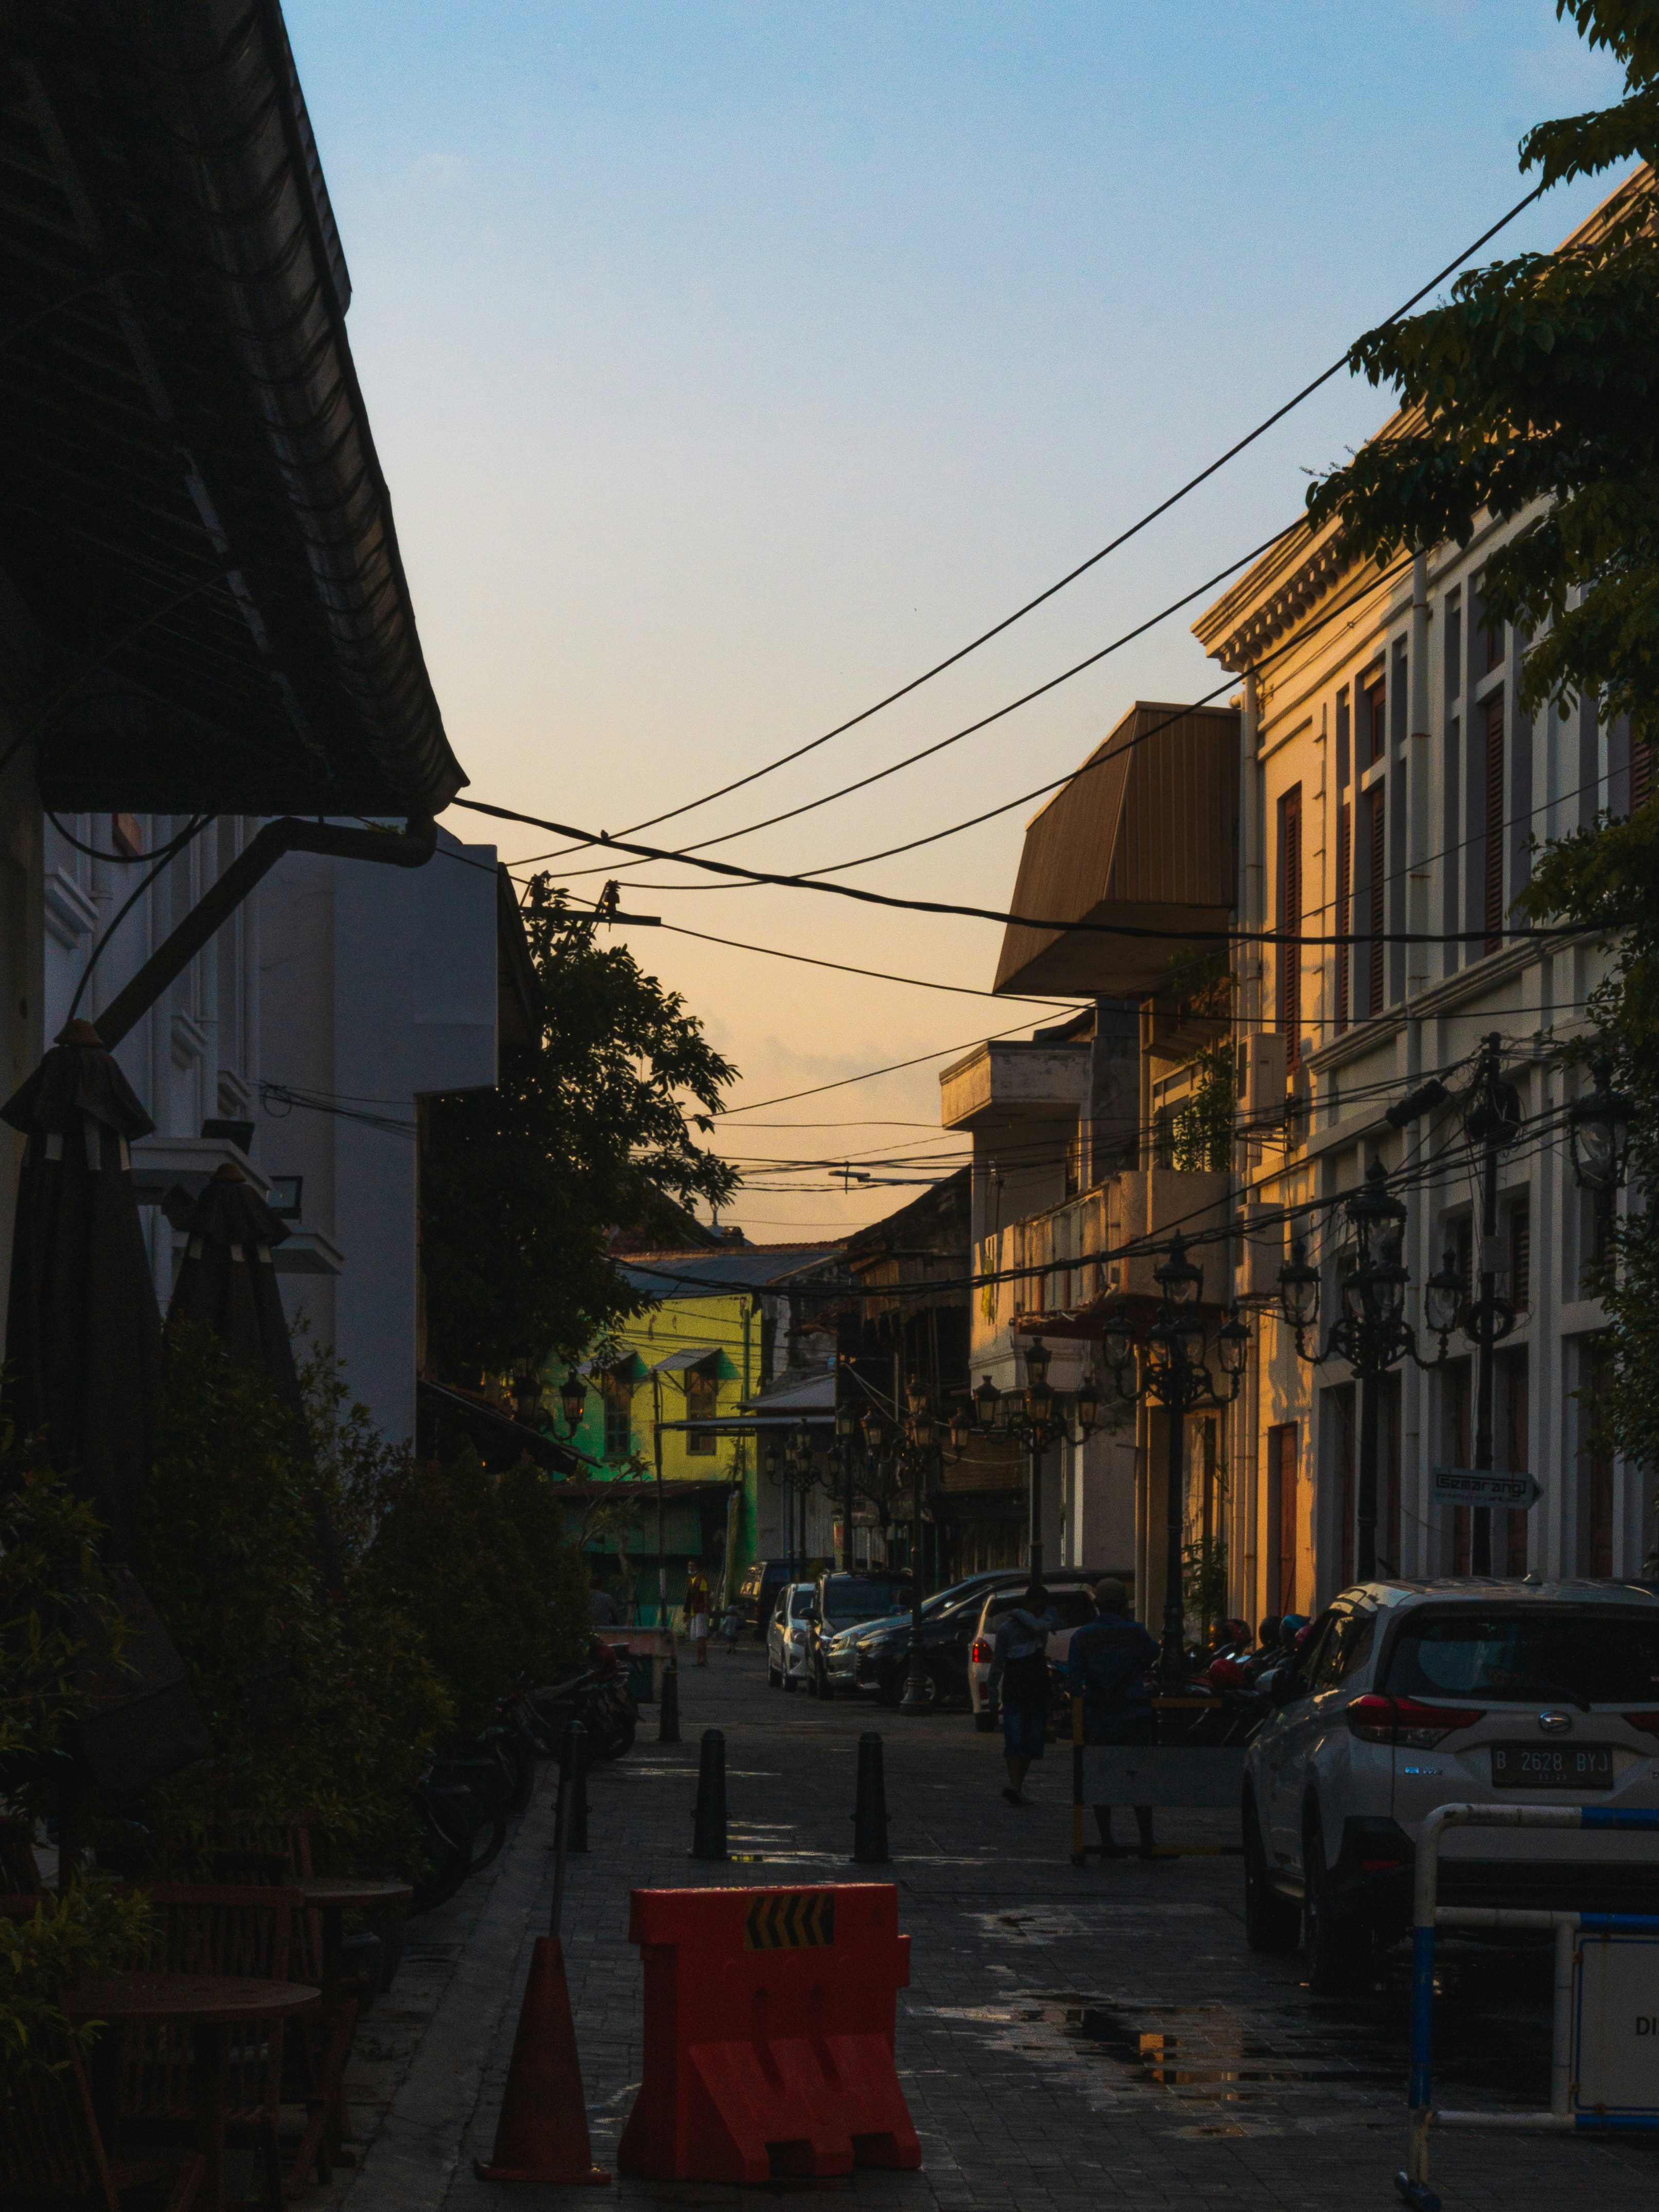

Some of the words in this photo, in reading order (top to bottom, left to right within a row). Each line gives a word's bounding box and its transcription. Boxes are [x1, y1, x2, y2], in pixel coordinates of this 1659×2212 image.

[1496, 1750, 1507, 1769] B
[1521, 1751, 1563, 1771] 2628
[1576, 1753, 1609, 1772] BYJ
[1636, 2016, 1659, 2035] DI
